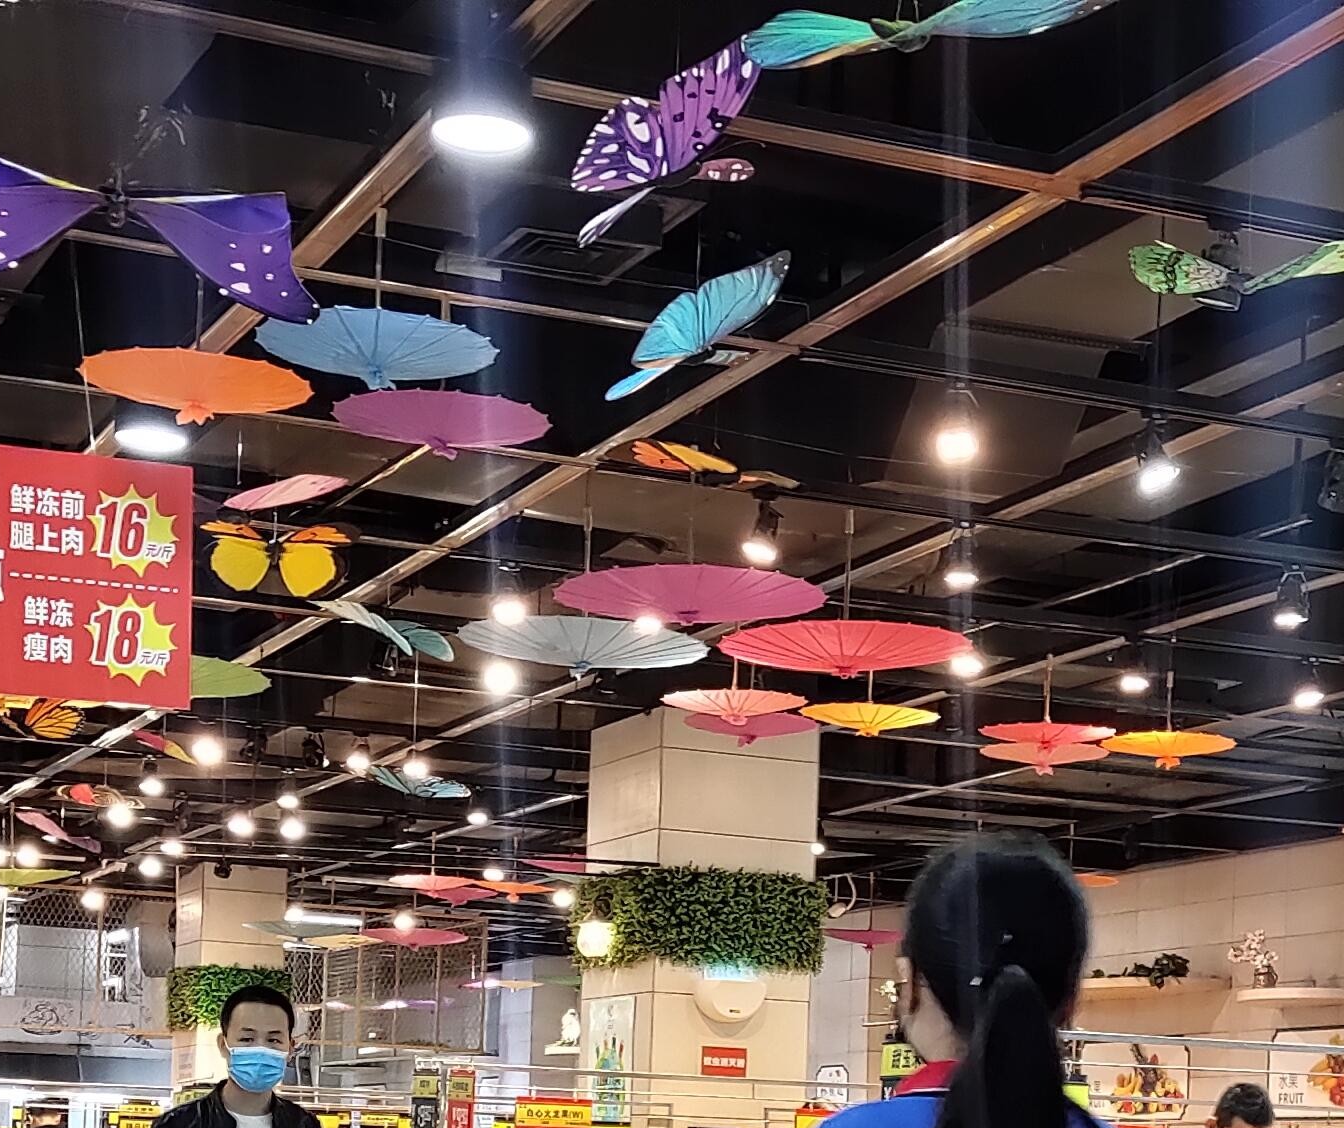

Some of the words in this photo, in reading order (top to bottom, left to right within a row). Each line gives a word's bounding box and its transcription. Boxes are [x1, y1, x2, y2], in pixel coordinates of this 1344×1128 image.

[9, 483, 86, 521] 鲜冻前
[9, 521, 85, 556] 腿上肉
[96, 500, 148, 559] 16
[145, 543, 173, 560] 元/斤
[22, 595, 75, 628] 鲜冻
[22, 632, 74, 665] 瘦肉
[91, 608, 142, 667] 18
[139, 651, 168, 667] 元/斤
[1278, 1075, 1299, 1090] 水果
[1278, 1092, 1305, 1105] FRUIT
